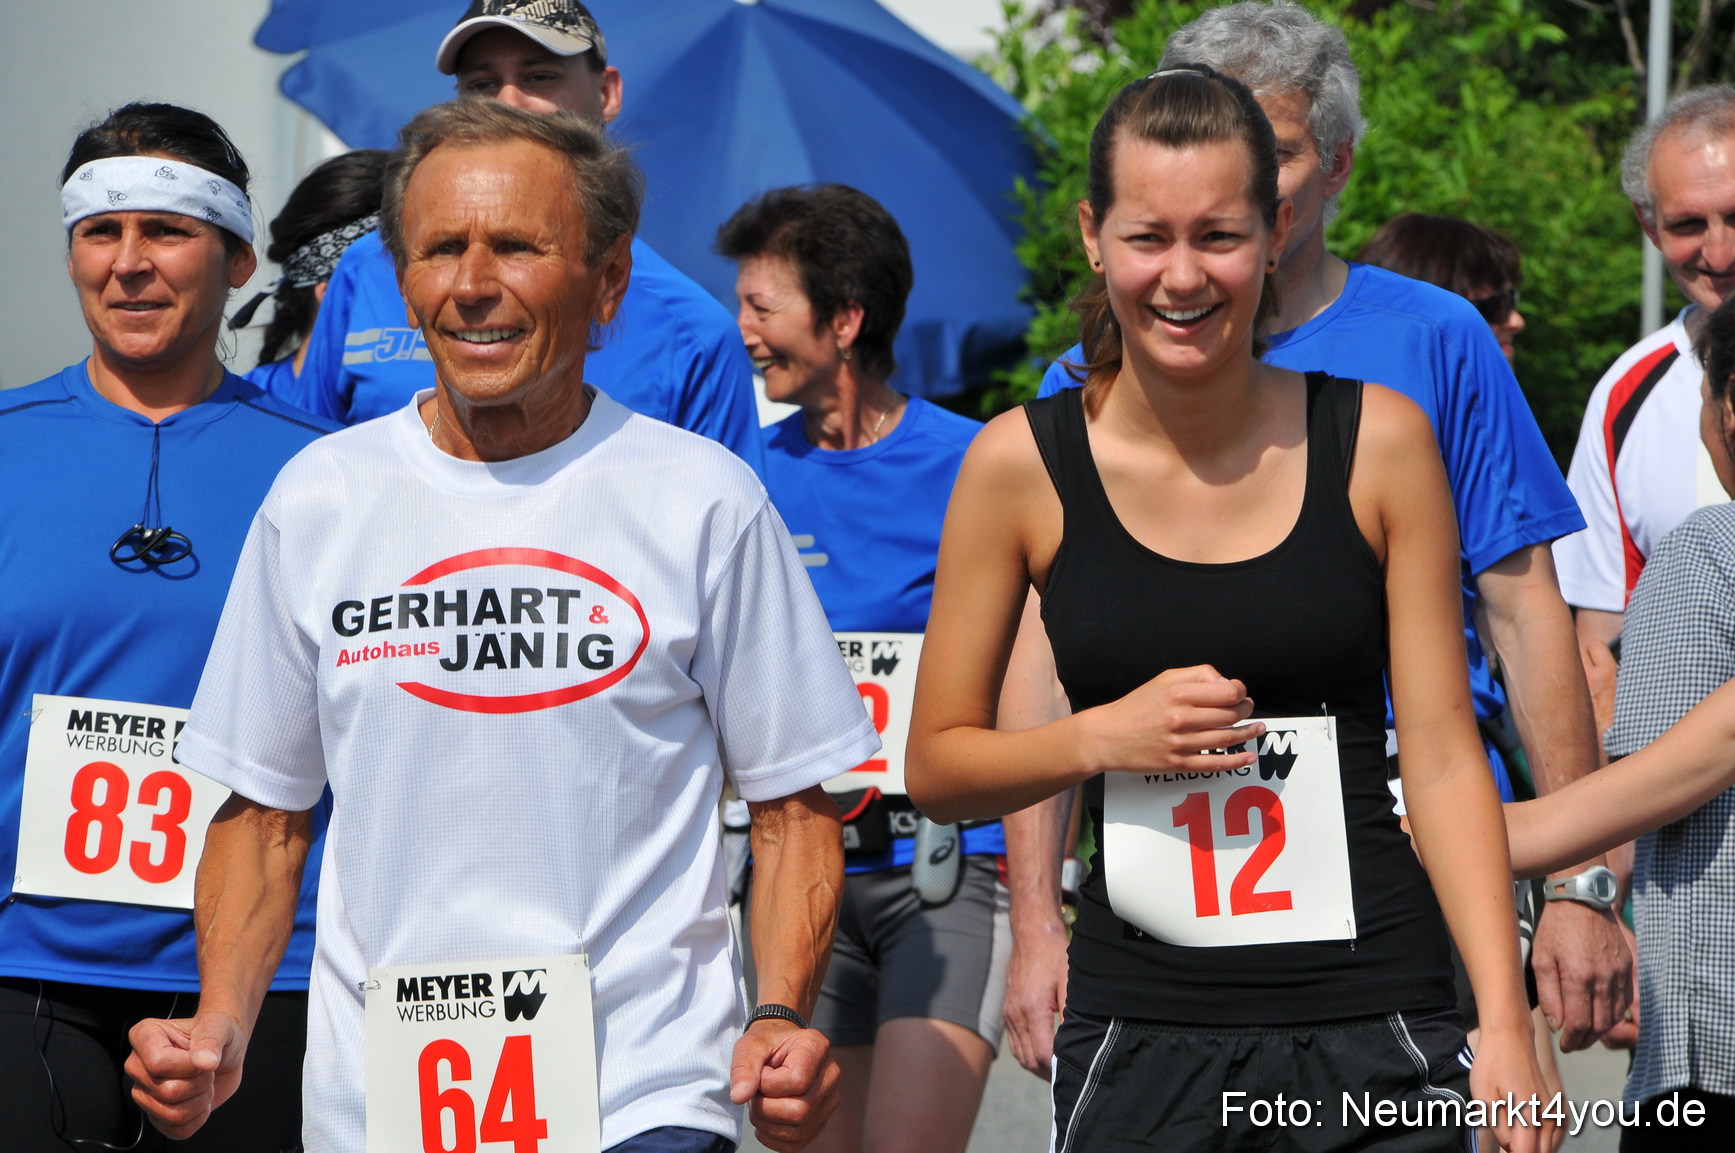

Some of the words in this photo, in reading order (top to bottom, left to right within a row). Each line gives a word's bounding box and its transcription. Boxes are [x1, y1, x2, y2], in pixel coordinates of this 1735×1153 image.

[331, 587, 581, 637] GERHART
[588, 604, 610, 624] &
[336, 640, 440, 667] Autohaus
[439, 631, 614, 671] JÄNIG
[66, 709, 166, 740] MEYER
[66, 732, 165, 757] WERBUNG
[63, 761, 192, 884] 83
[1171, 785, 1294, 918] 12
[396, 972, 495, 1003] MEYER
[396, 1000, 497, 1023] WERBUNG
[417, 1034, 548, 1153] 64
